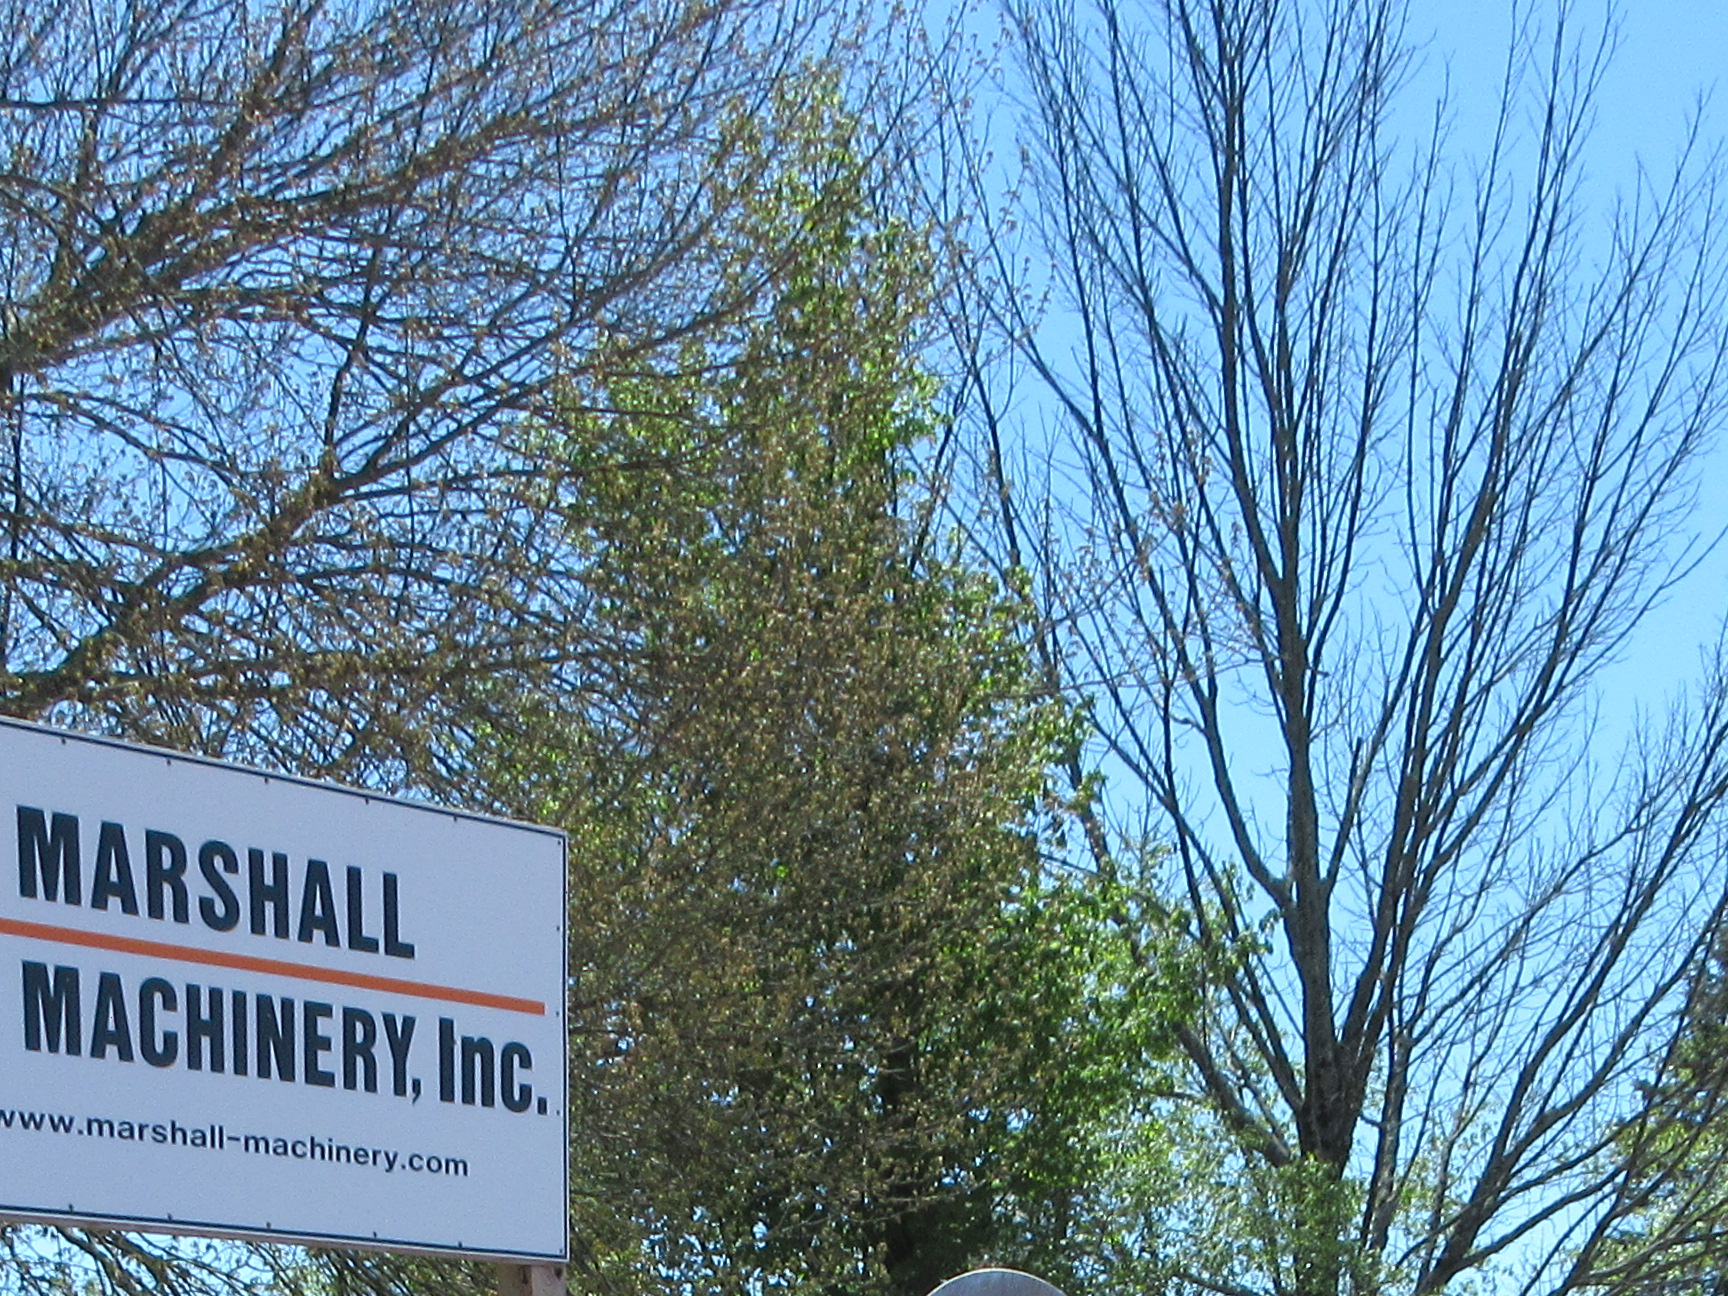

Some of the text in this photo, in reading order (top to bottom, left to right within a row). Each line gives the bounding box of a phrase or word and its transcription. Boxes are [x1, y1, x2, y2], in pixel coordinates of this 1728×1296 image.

[16, 804, 416, 960] MARSHALL
[21, 959, 550, 1116] MACHINERY, Inc.
